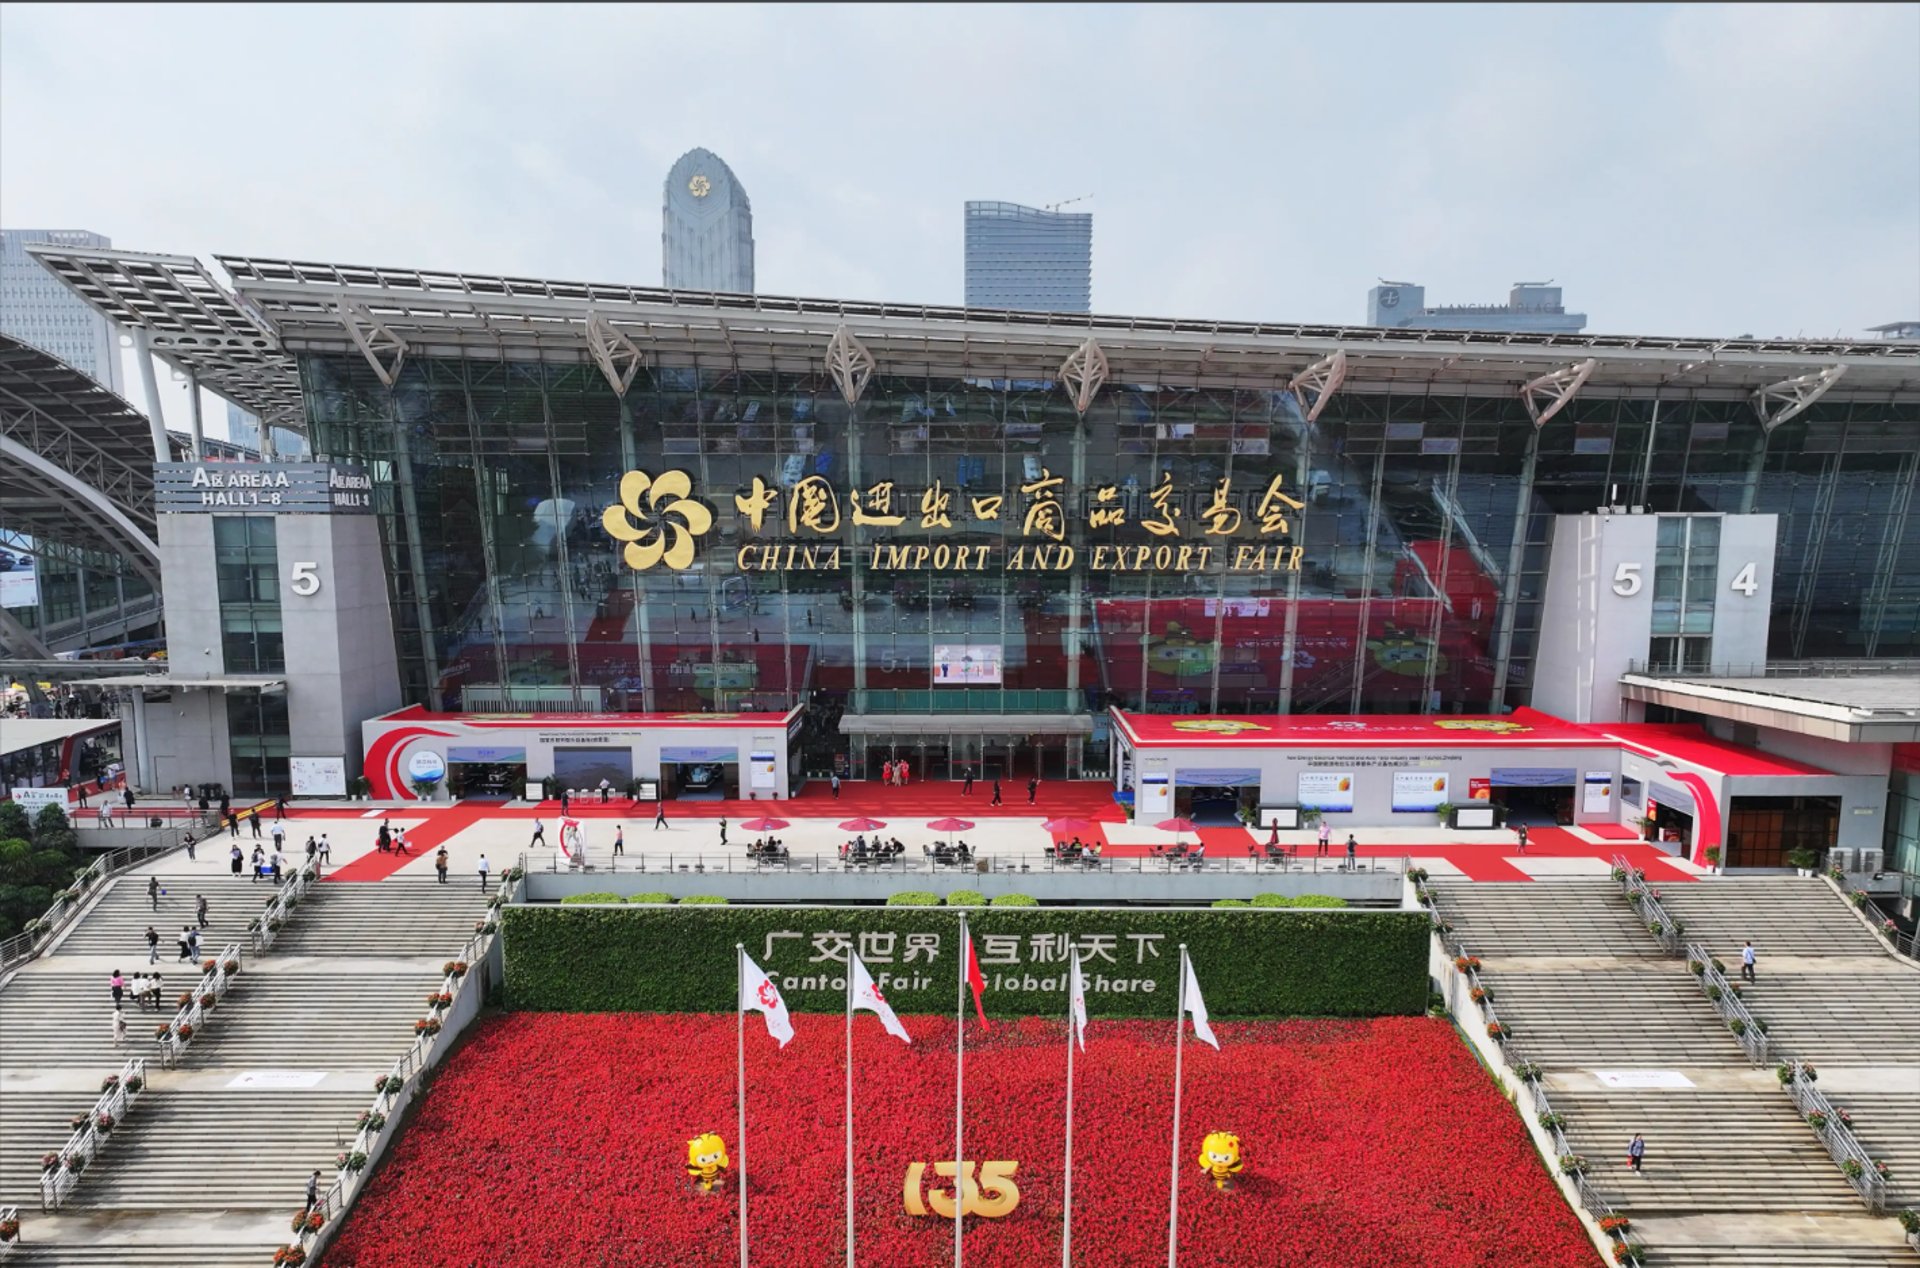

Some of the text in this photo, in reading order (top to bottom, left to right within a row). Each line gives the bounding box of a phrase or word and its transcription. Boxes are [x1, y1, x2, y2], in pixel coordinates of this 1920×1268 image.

[228, 474, 273, 487] AREA
[275, 471, 289, 487] A
[737, 544, 1305, 571] CHINA IMPORT AND EXPORT FAIR
[290, 561, 321, 596] 5
[1612, 562, 1643, 597] 5
[1731, 562, 1759, 597] 4
[762, 930, 1166, 965] 广交世界 互利天下
[765, 971, 847, 991] anto
[878, 971, 933, 991] Fair
[903, 1160, 1021, 1219] 135
